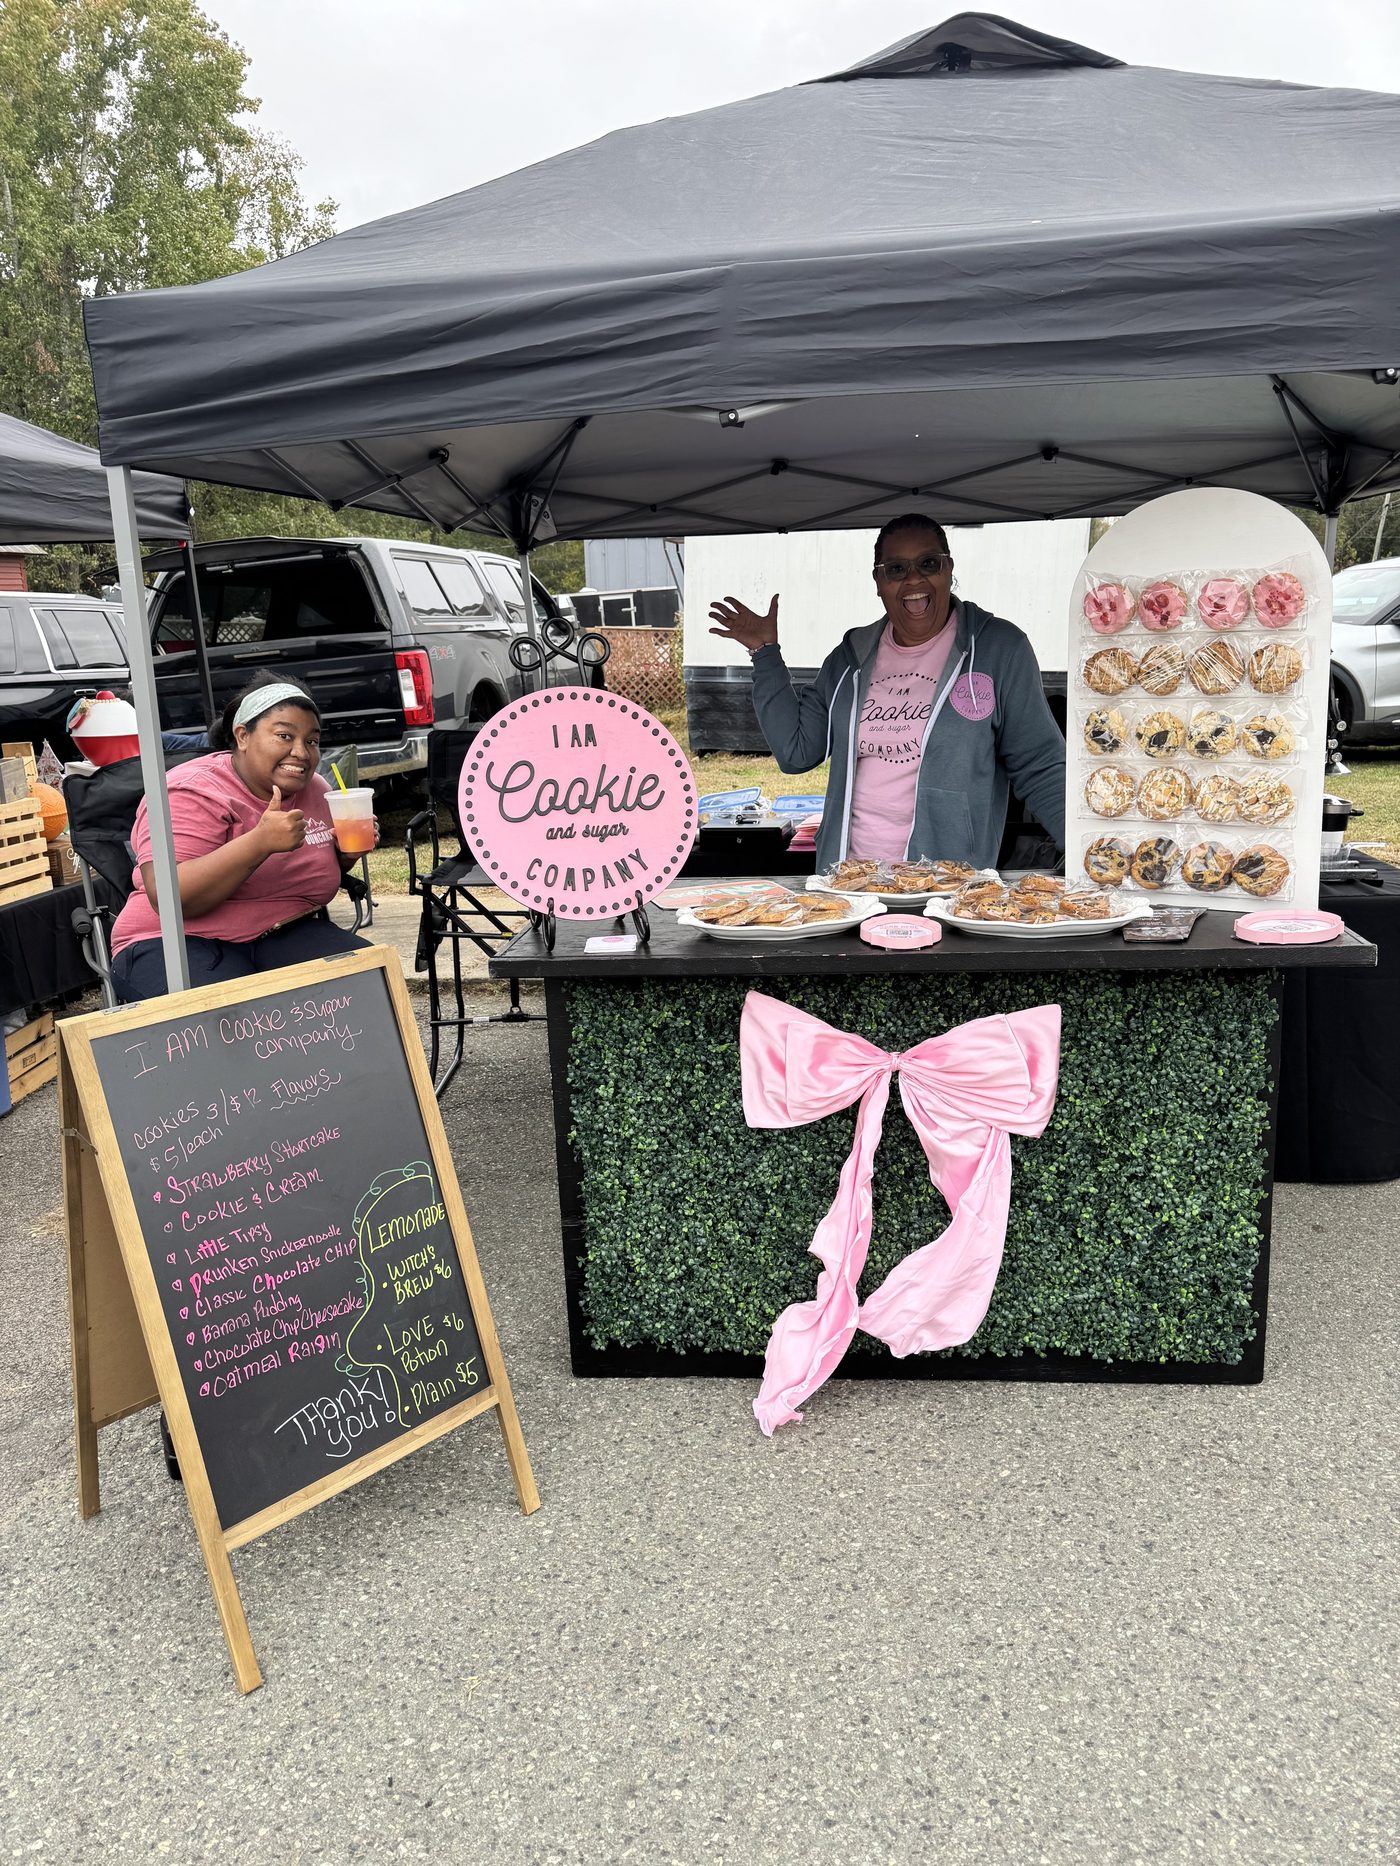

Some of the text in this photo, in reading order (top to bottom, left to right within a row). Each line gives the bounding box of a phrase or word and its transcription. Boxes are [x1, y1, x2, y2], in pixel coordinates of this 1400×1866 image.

[552, 723, 598, 749] I AM
[868, 724, 912, 735] and sugar
[859, 737, 920, 756] COMPANY
[485, 760, 666, 823] Cookie
[546, 821, 630, 843] and sugar
[526, 848, 649, 892] COMPANY
[125, 1041, 158, 1079] I
[166, 1024, 209, 1063] AM
[455, 1356, 479, 1386] $5
